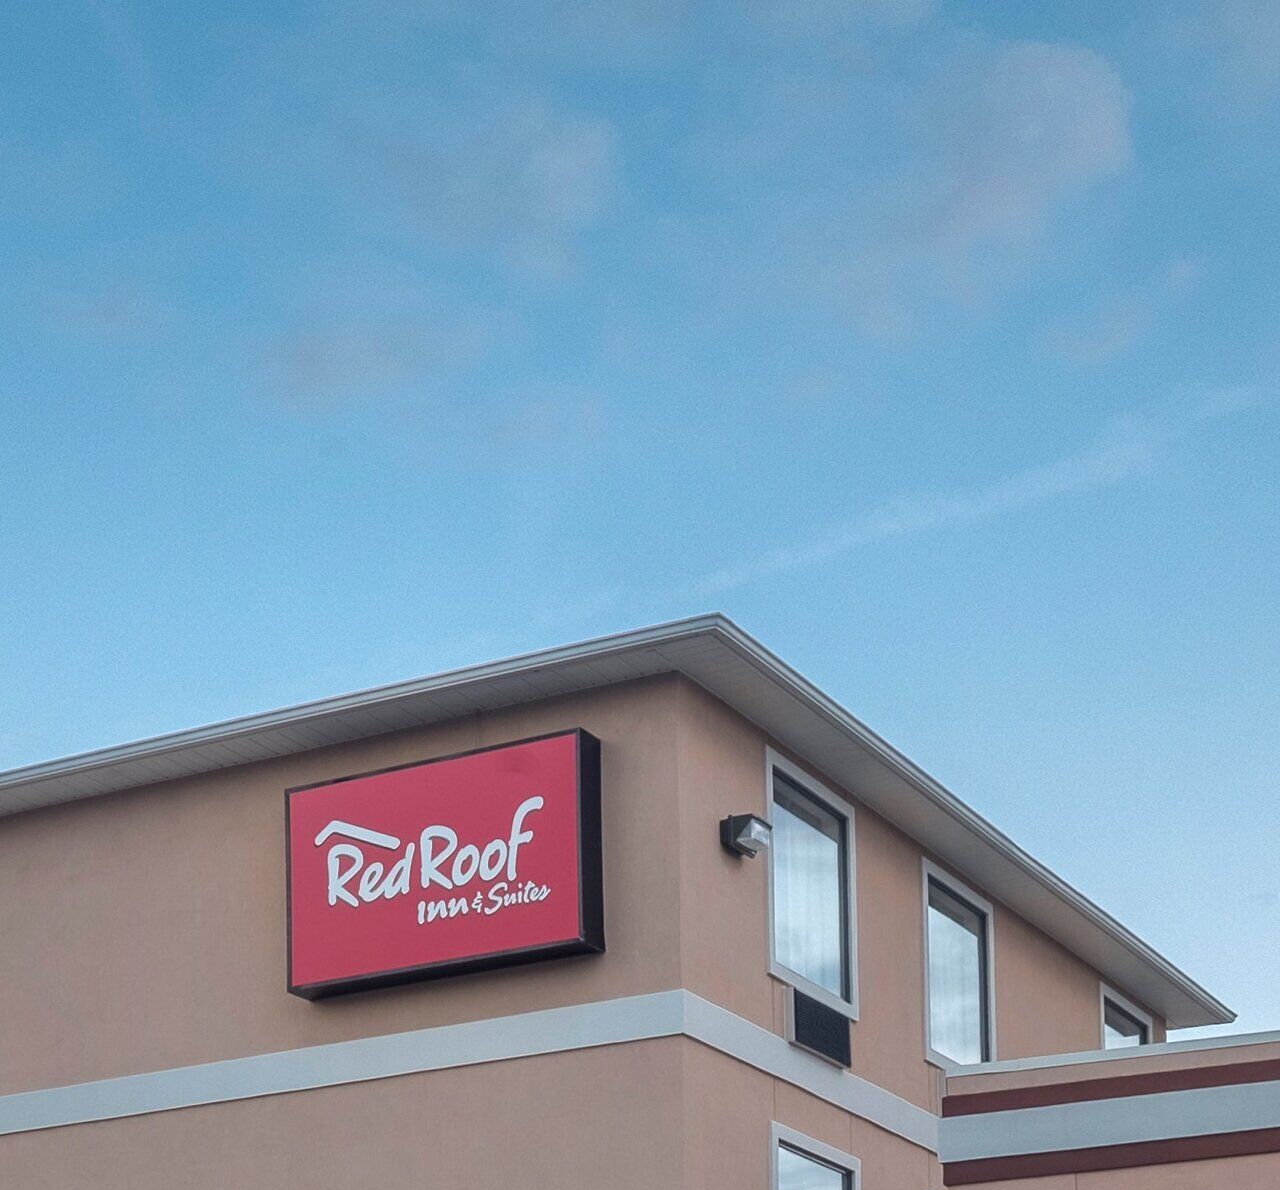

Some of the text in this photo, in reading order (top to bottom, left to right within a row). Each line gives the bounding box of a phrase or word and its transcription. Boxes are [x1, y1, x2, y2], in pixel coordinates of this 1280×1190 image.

[327, 796, 543, 907] Red Roof
[471, 891, 483, 913] &
[484, 880, 551, 915] Suites
